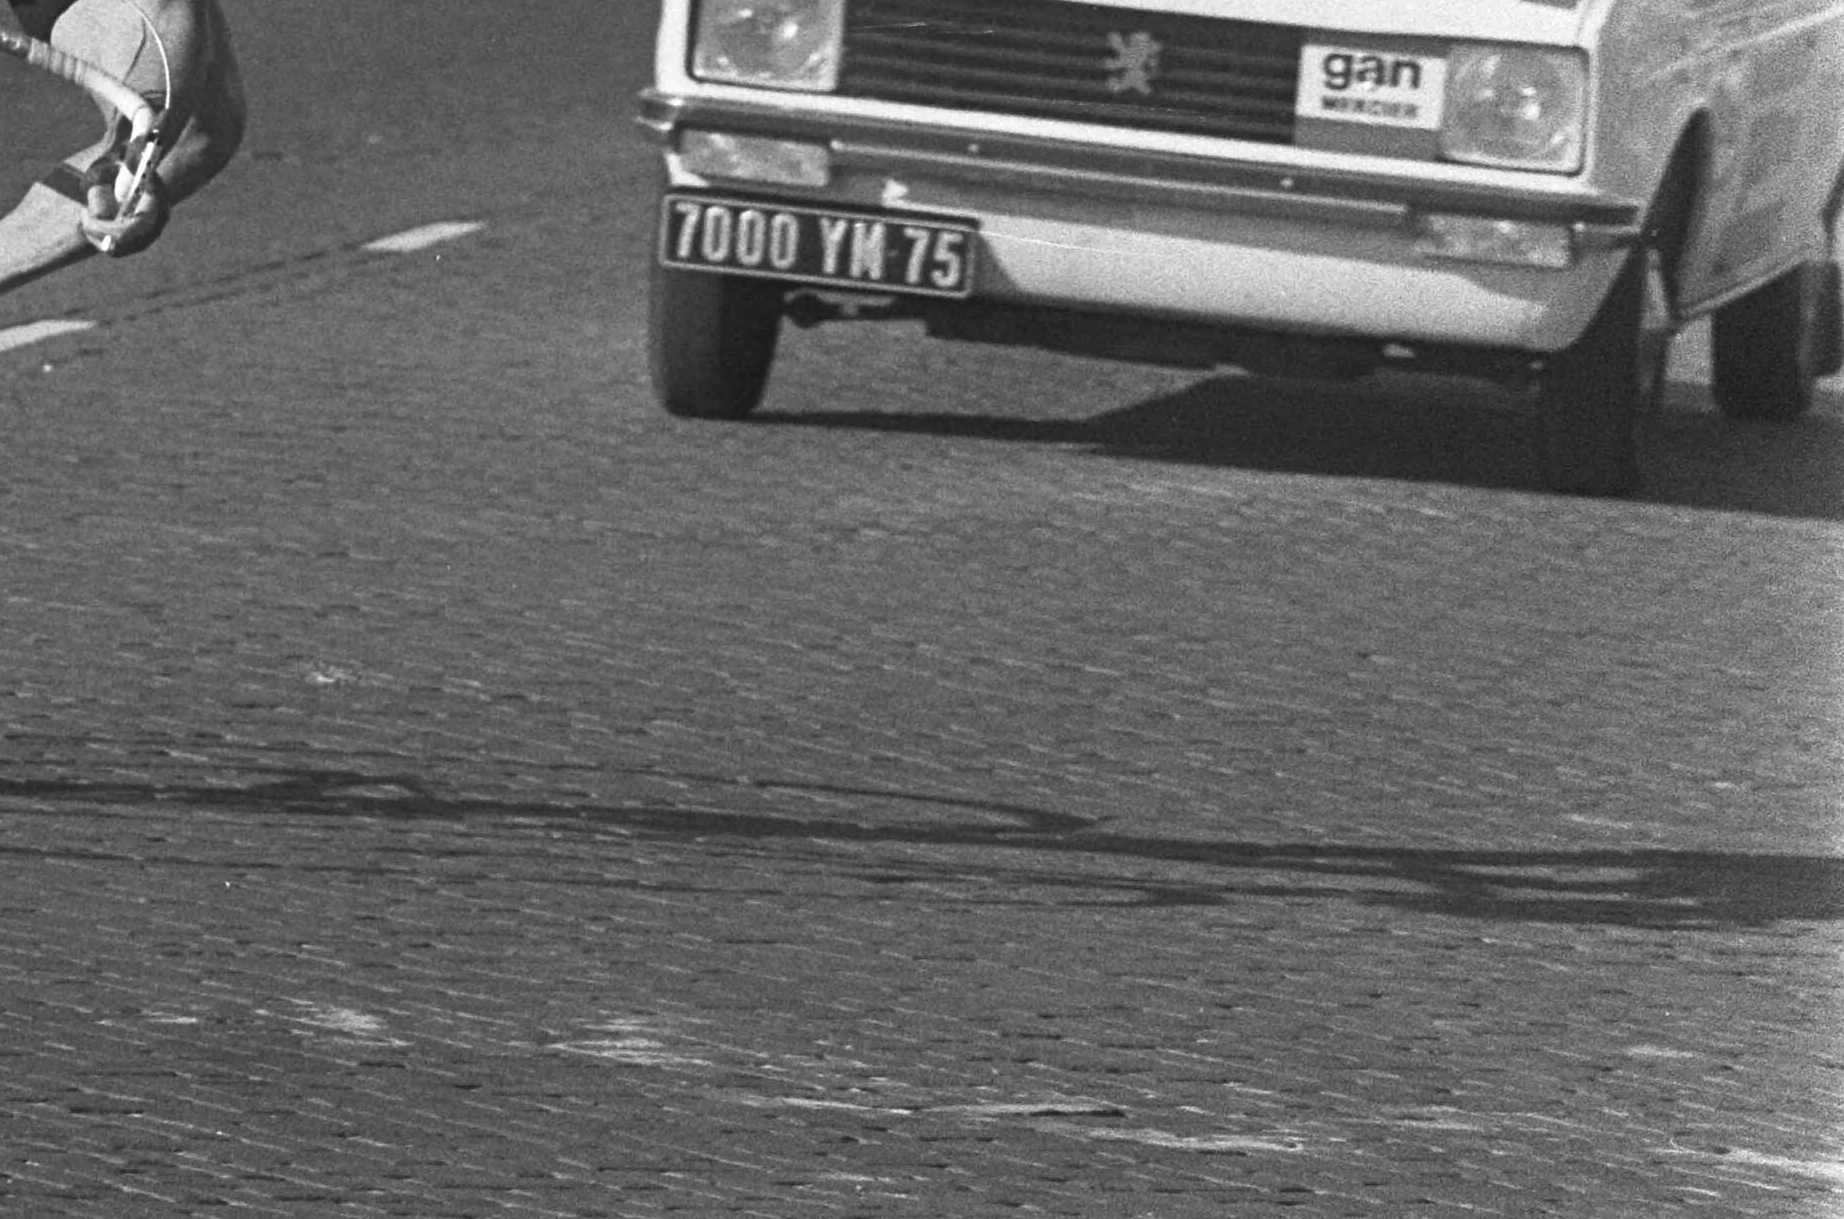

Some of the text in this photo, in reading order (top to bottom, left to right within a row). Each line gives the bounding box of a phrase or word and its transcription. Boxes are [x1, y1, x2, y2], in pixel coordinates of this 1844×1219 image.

[1322, 52, 1422, 91] gan
[674, 202, 964, 288] 7000 YM 75
